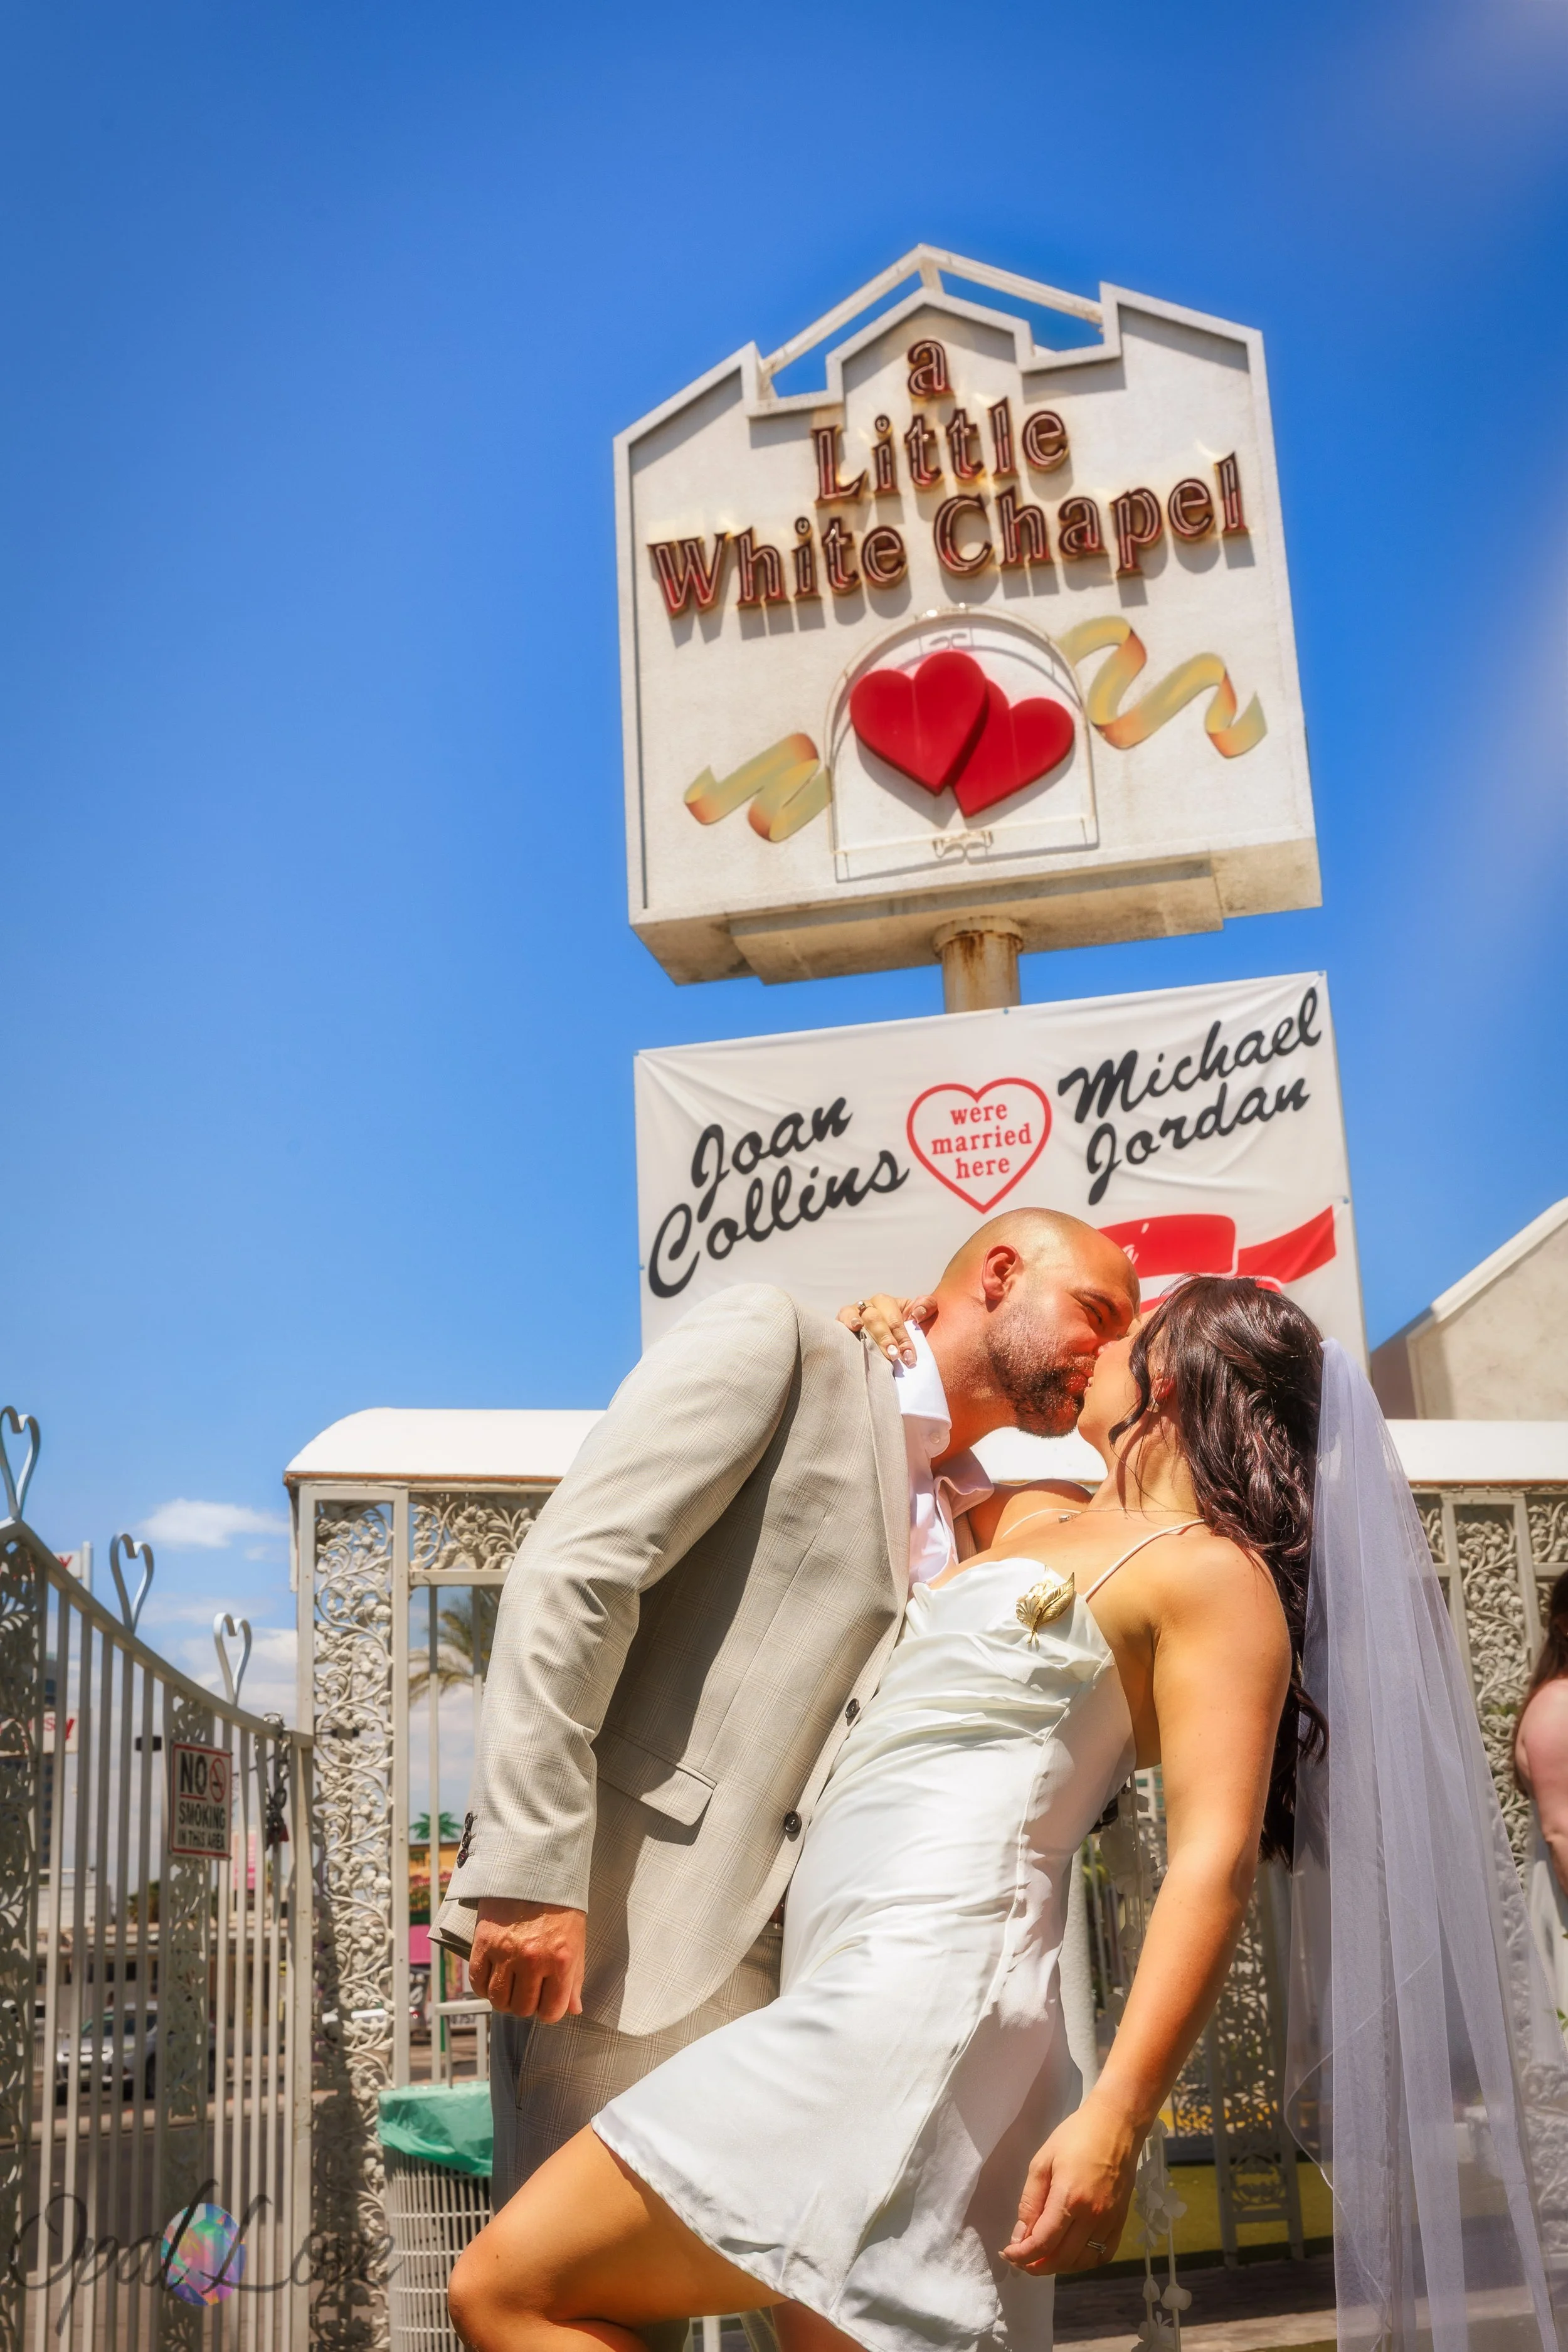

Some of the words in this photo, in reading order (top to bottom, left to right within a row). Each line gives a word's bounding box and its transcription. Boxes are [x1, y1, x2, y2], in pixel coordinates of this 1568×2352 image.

[907, 339, 955, 403] a
[810, 397, 1071, 510] Little
[647, 516, 908, 621] White
[933, 452, 1249, 578] Chapel
[1057, 987, 1322, 1125] Michael
[931, 1121, 1033, 1156] married
[950, 1103, 1008, 1126] were
[1086, 1078, 1310, 1205] Jordan
[691, 1096, 852, 1223] Joan
[955, 1157, 1011, 1180] here
[649, 1150, 909, 1298] Collins
[180, 1751, 207, 1795] NO
[177, 1829, 187, 1845] IN
[189, 1830, 206, 1847] THIS
[207, 1833, 225, 1849] AREA
[179, 1801, 226, 1830] SMOKING
